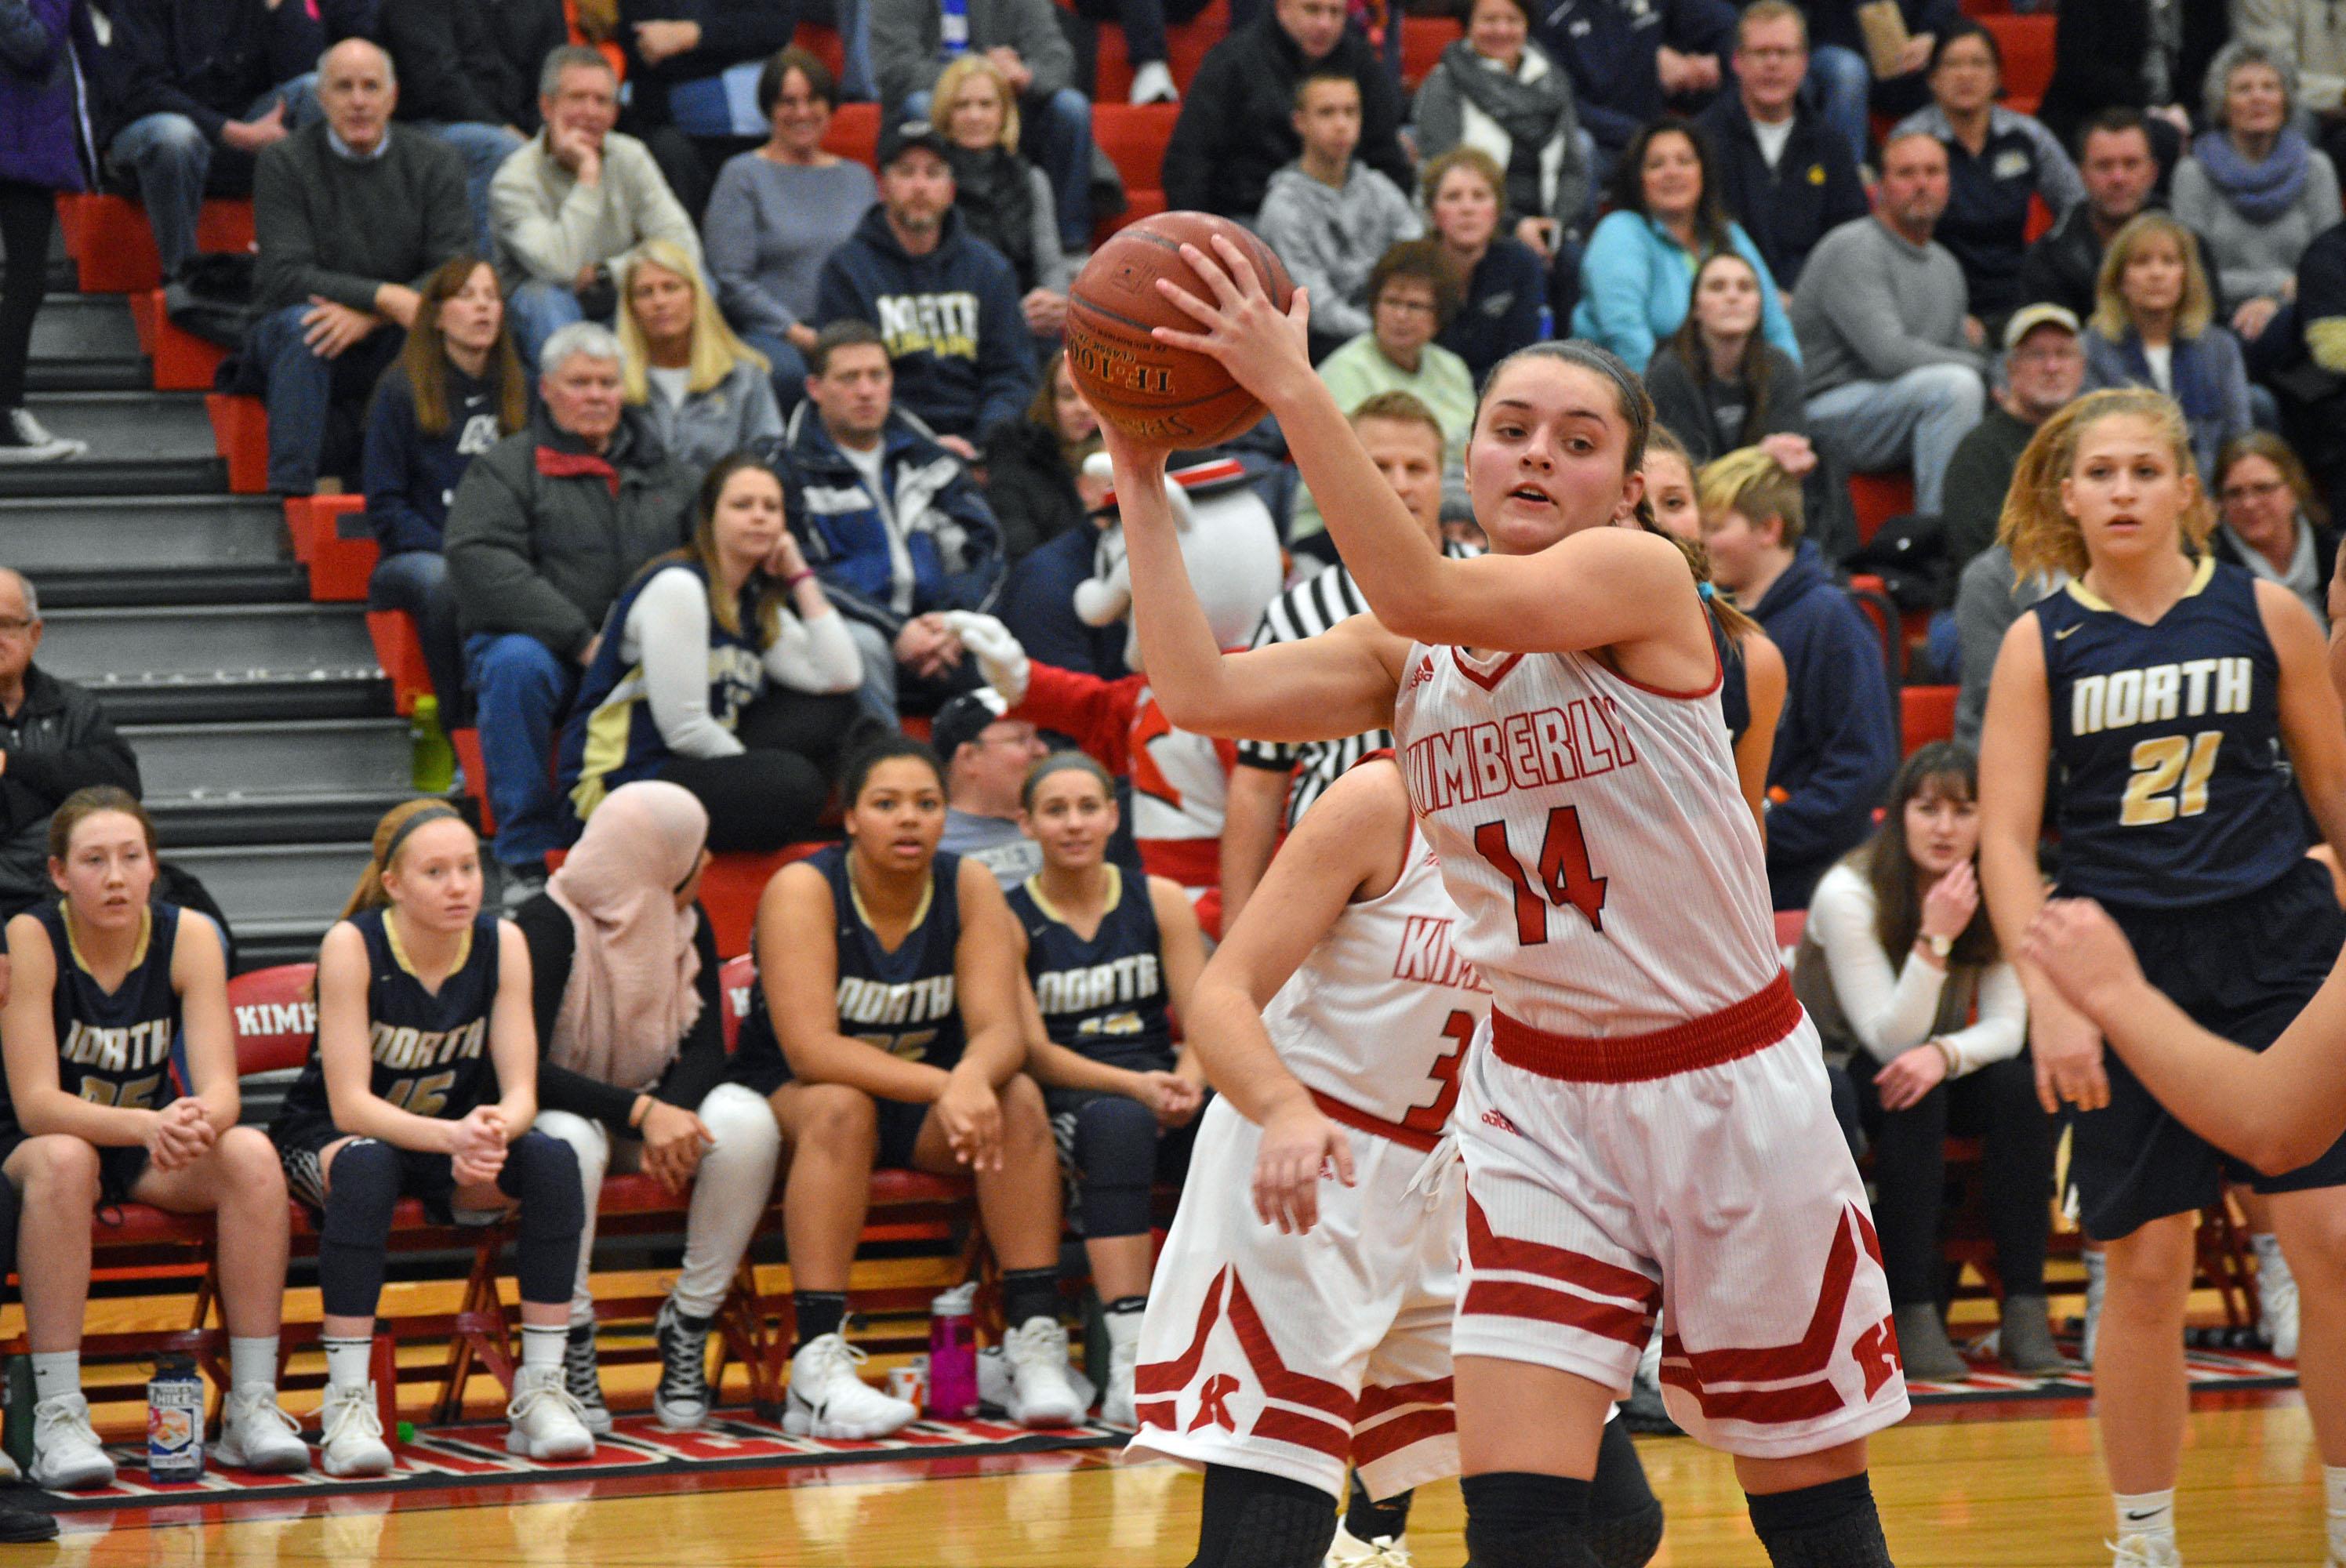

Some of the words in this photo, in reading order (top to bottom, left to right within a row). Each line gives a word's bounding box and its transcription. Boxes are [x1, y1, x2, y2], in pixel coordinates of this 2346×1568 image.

[2072, 656, 2254, 737] NORTH
[1406, 695, 1638, 820] KIMBERLY
[2119, 730, 2225, 827] 21
[1473, 804, 1609, 947] 14
[836, 975, 955, 1024] NORTH
[1186, 1373, 1240, 1435] K
